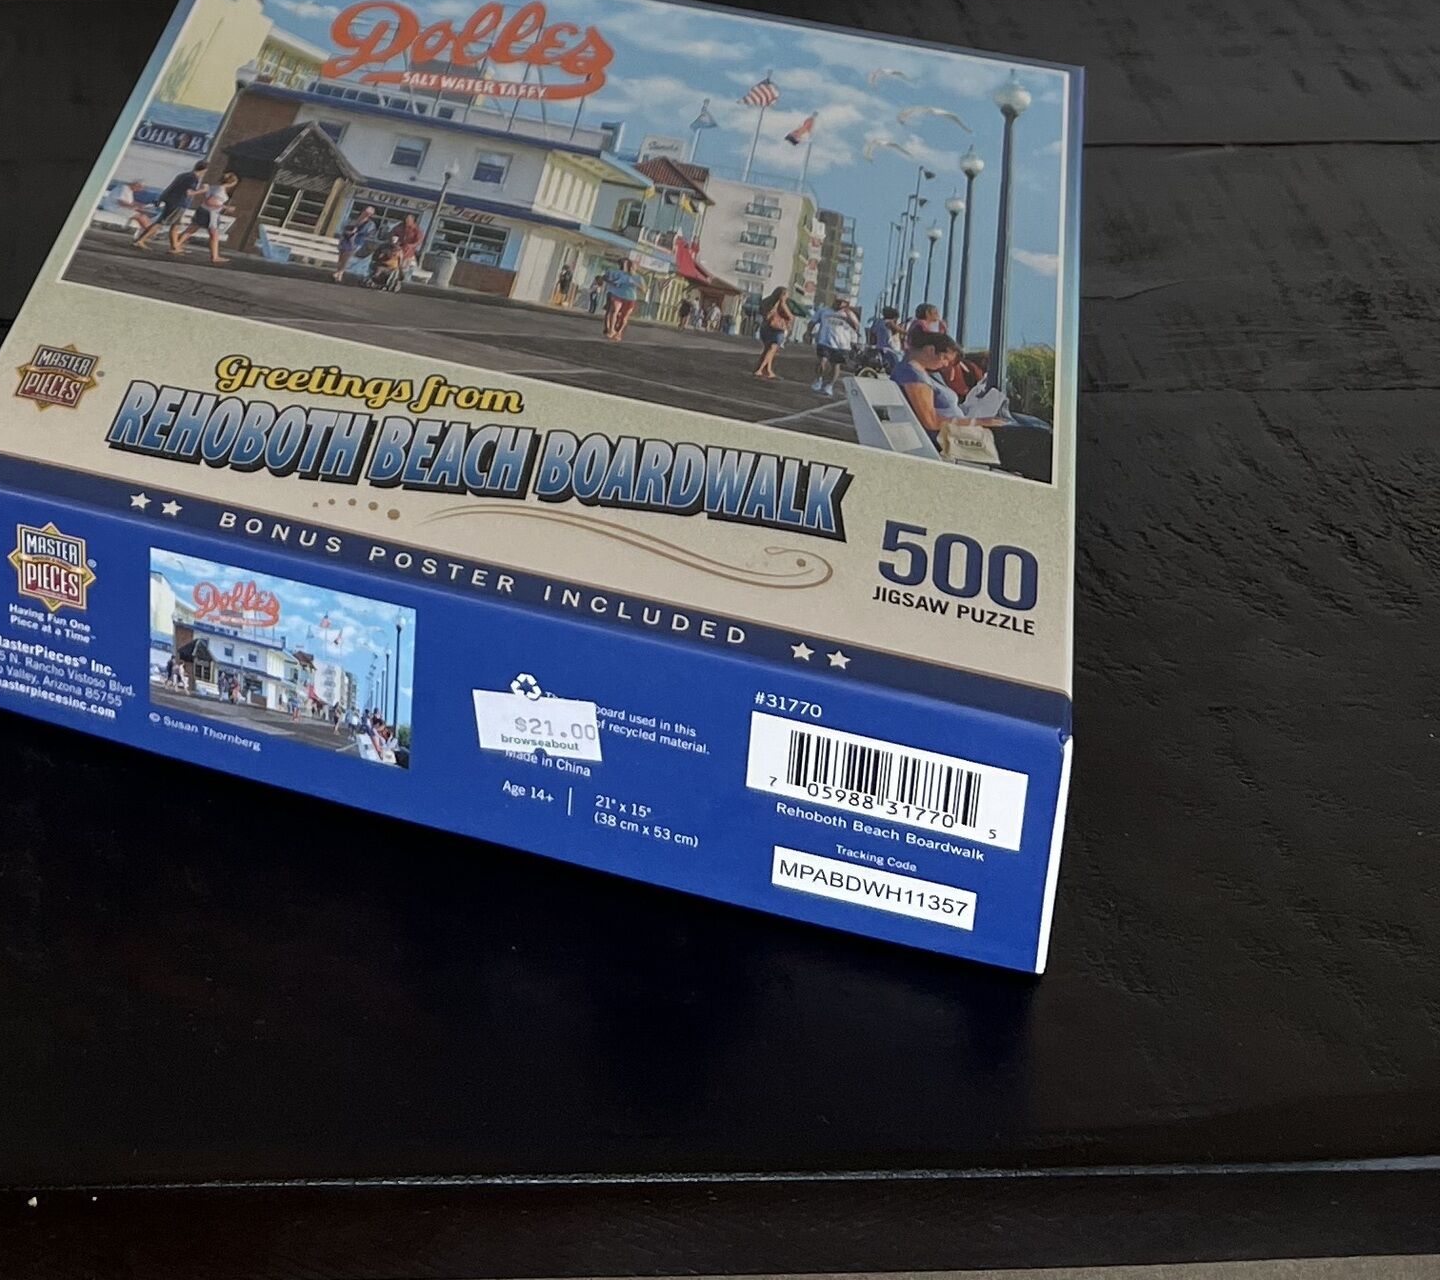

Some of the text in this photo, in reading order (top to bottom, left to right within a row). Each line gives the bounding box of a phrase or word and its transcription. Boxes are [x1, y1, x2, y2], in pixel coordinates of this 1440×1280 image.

[401, 71, 548, 99] SALT WATER TAFFY
[37, 349, 91, 376] MASTER
[24, 372, 80, 400] PIECES
[215, 354, 524, 414] Greetings from
[107, 379, 854, 543] REHOBOTH BEACH BOARDWALK
[26, 533, 77, 565] MASTER
[878, 519, 1039, 611] 500
[27, 562, 79, 597] PIECES
[218, 510, 747, 645] BONUS POSTER INCLUDED
[9, 603, 91, 632] Having Fun One
[10, 614, 39, 629] Piece
[41, 623, 52, 634] at
[54, 627, 62, 636] a
[872, 586, 1035, 635] JIGSAW PUZZLE
[10, 651, 22, 664] N.
[25, 656, 65, 677] Rancho
[67, 667, 106, 689] Vistoso
[109, 679, 137, 698] Blvd.
[91, 659, 117, 677] Inc.
[42, 675, 83, 696] Arizona
[84, 687, 123, 708] 85755
[754, 691, 823, 718] #31770
[163, 715, 199, 733] Susan
[202, 725, 262, 753] Thornberg
[514, 716, 596, 740] $21.00
[609, 721, 657, 742] recycled
[659, 734, 711, 755] material.
[629, 711, 656, 728] used
[659, 718, 671, 732] in
[674, 722, 697, 738] this
[500, 733, 580, 752] browseabout
[541, 752, 553, 768] in
[556, 758, 591, 777] China
[502, 779, 555, 803] Age 14+
[619, 802, 627, 813] x
[768, 775, 997, 840] 7 05988 31770 5
[593, 811, 699, 848] (38 cm x 53 cm)
[776, 801, 985, 862] Rehoboth Beach Boardwalk
[836, 844, 917, 872] Tracking Code
[779, 859, 968, 917] MPABDWH11357
